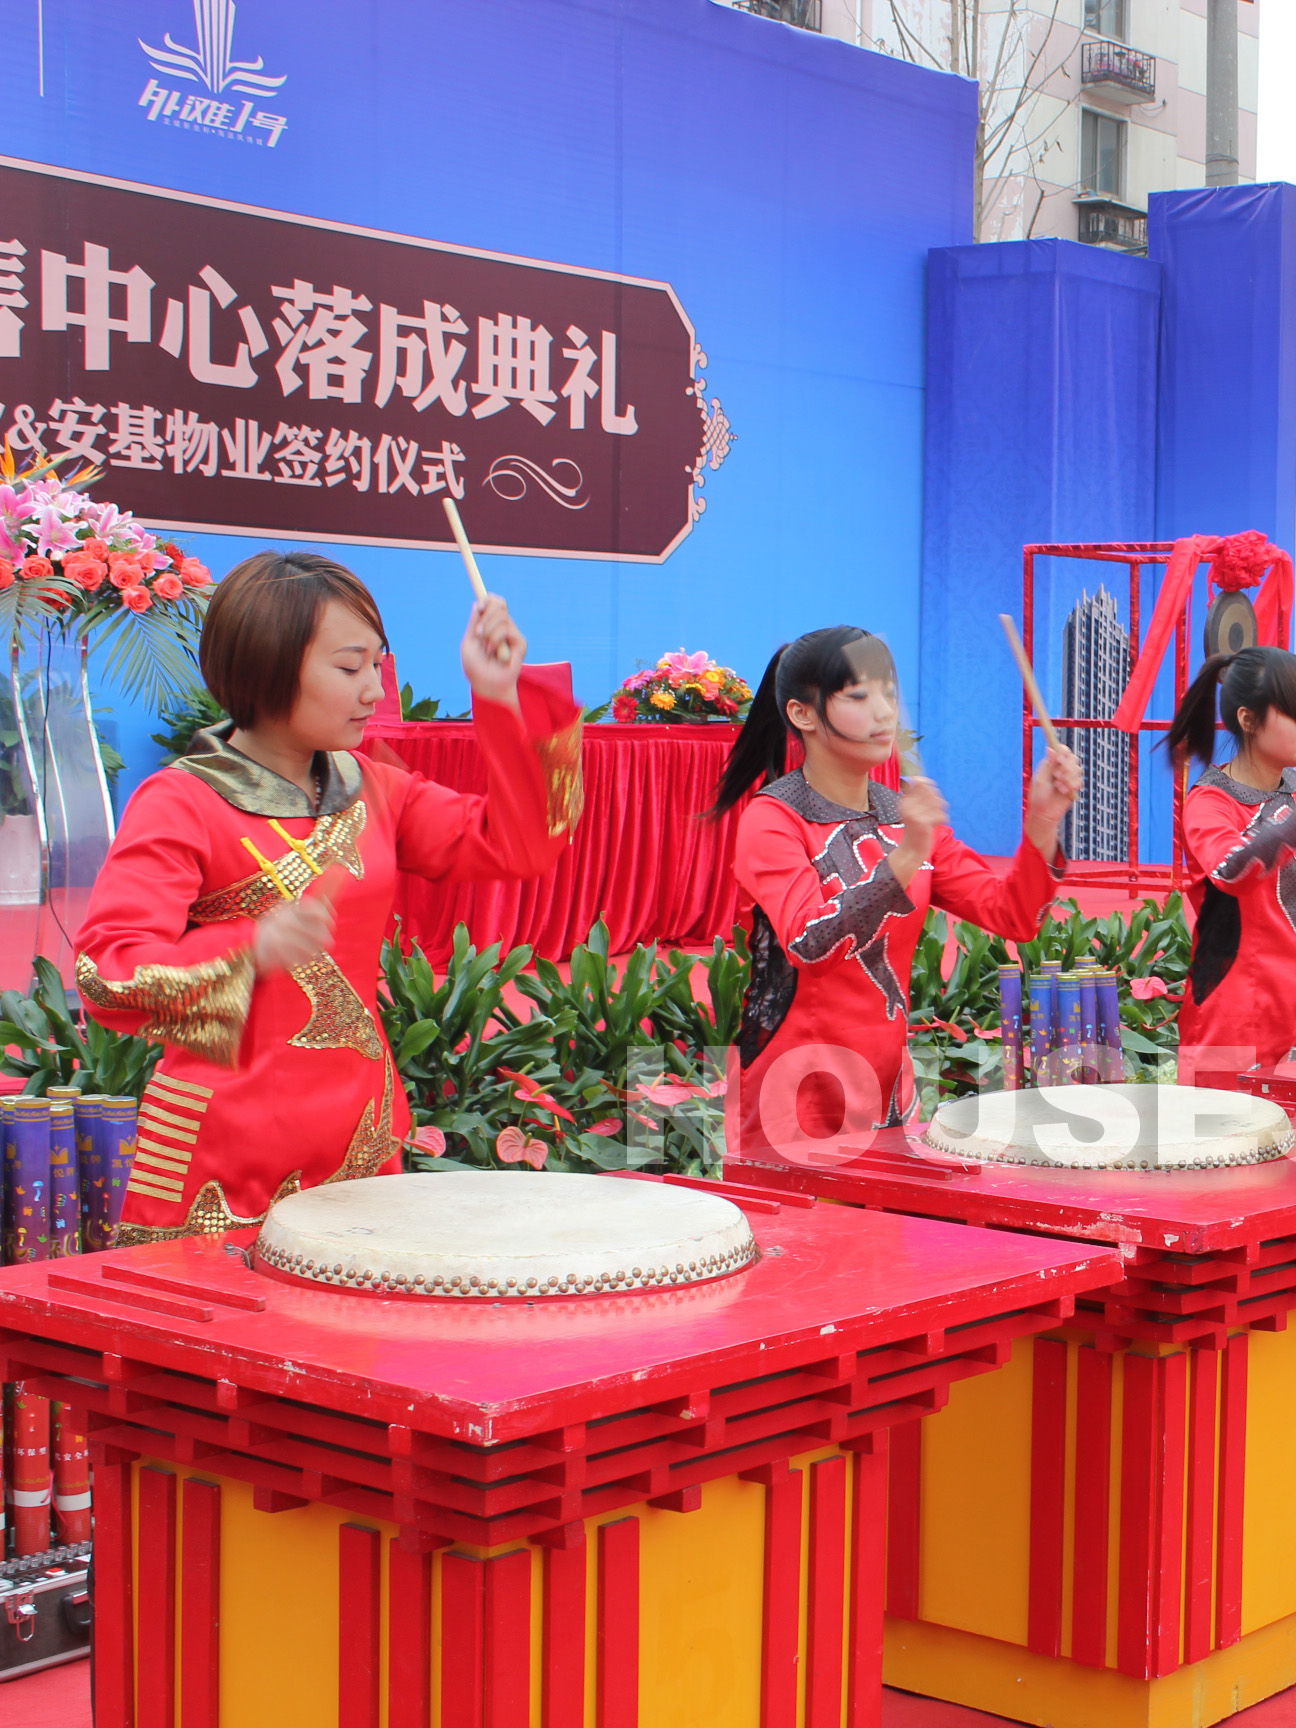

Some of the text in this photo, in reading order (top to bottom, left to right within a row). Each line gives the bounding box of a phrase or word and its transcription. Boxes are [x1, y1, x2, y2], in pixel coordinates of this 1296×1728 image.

[138, 78, 289, 148] 外滩1号
[0, 396, 466, 499] &安基物业签约仪式
